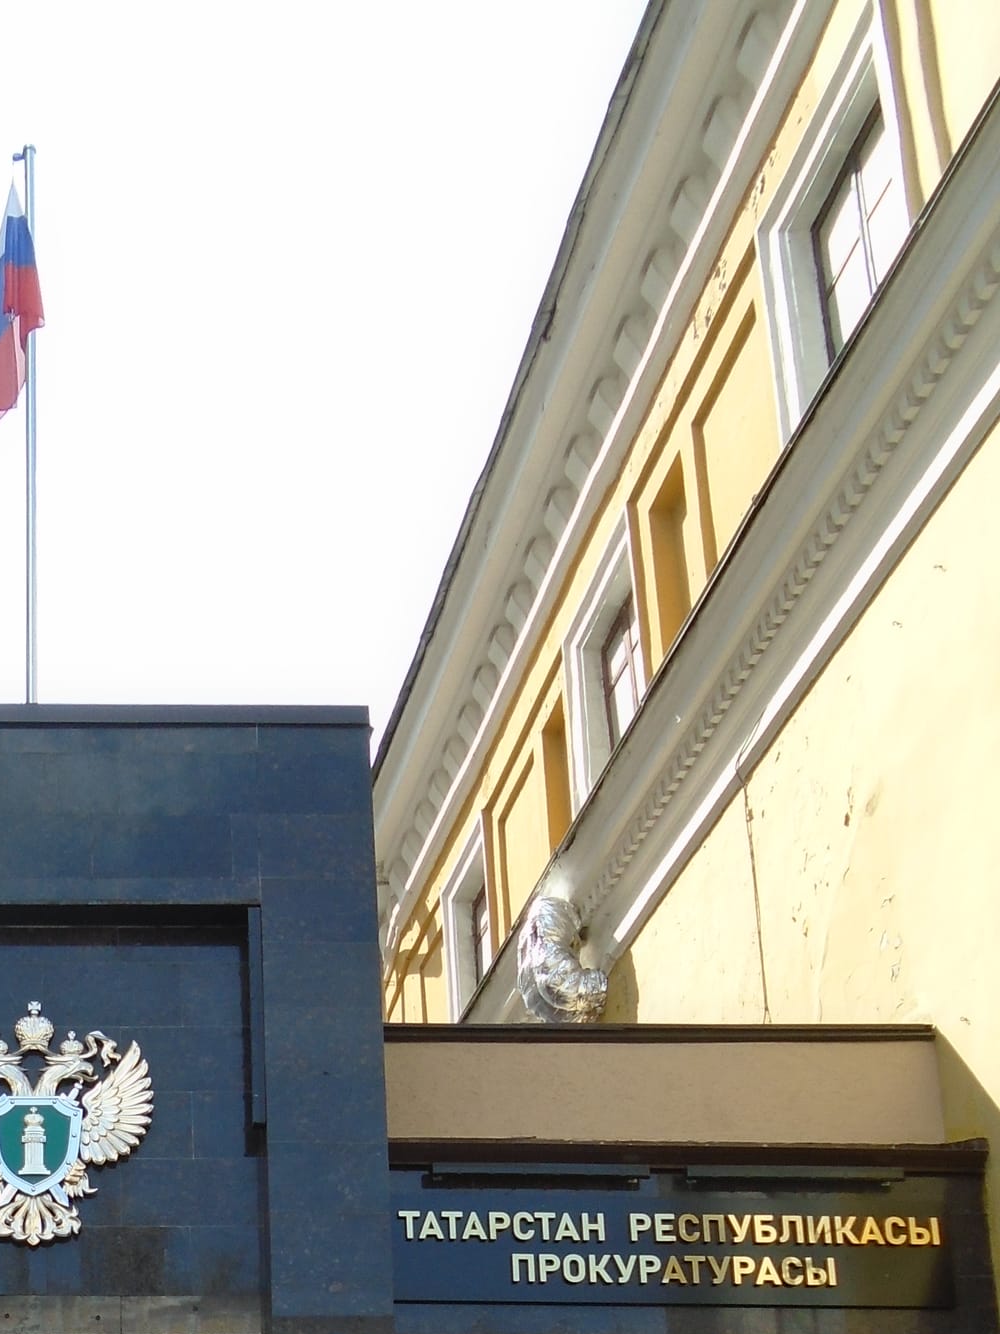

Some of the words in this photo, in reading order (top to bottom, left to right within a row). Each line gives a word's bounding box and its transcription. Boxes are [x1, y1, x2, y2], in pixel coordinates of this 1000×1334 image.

[398, 1210, 605, 1242] ТАТАРСТАН
[629, 1212, 941, 1246] РЕСПУБЛИКАСЫ
[511, 1253, 836, 1286] ПРОКУРАТУРАСЫ
